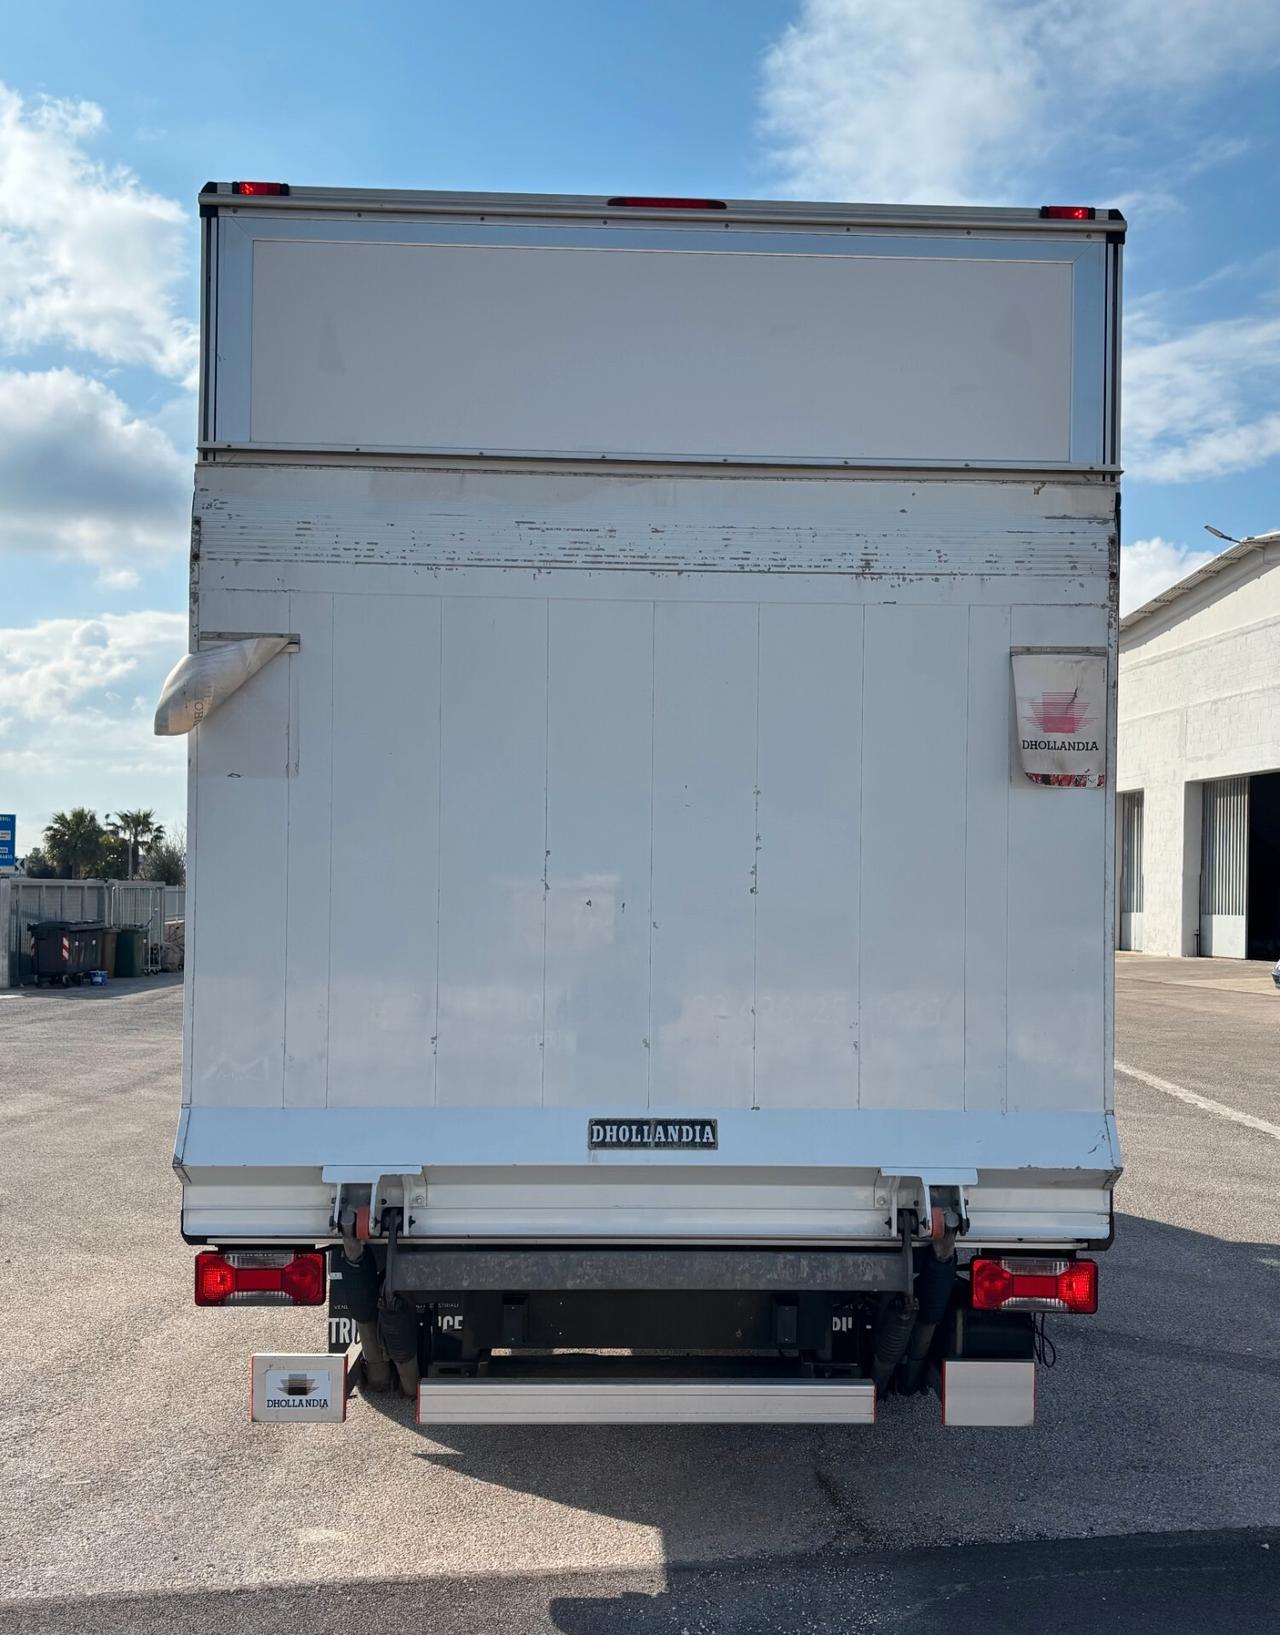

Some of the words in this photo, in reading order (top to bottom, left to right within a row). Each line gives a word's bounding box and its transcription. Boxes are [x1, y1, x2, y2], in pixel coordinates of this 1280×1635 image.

[1021, 740, 1099, 752] DHOLLANDIA
[591, 1125, 715, 1143] DHOLLANDIA
[266, 1398, 329, 1408] DHOLLANDIA
